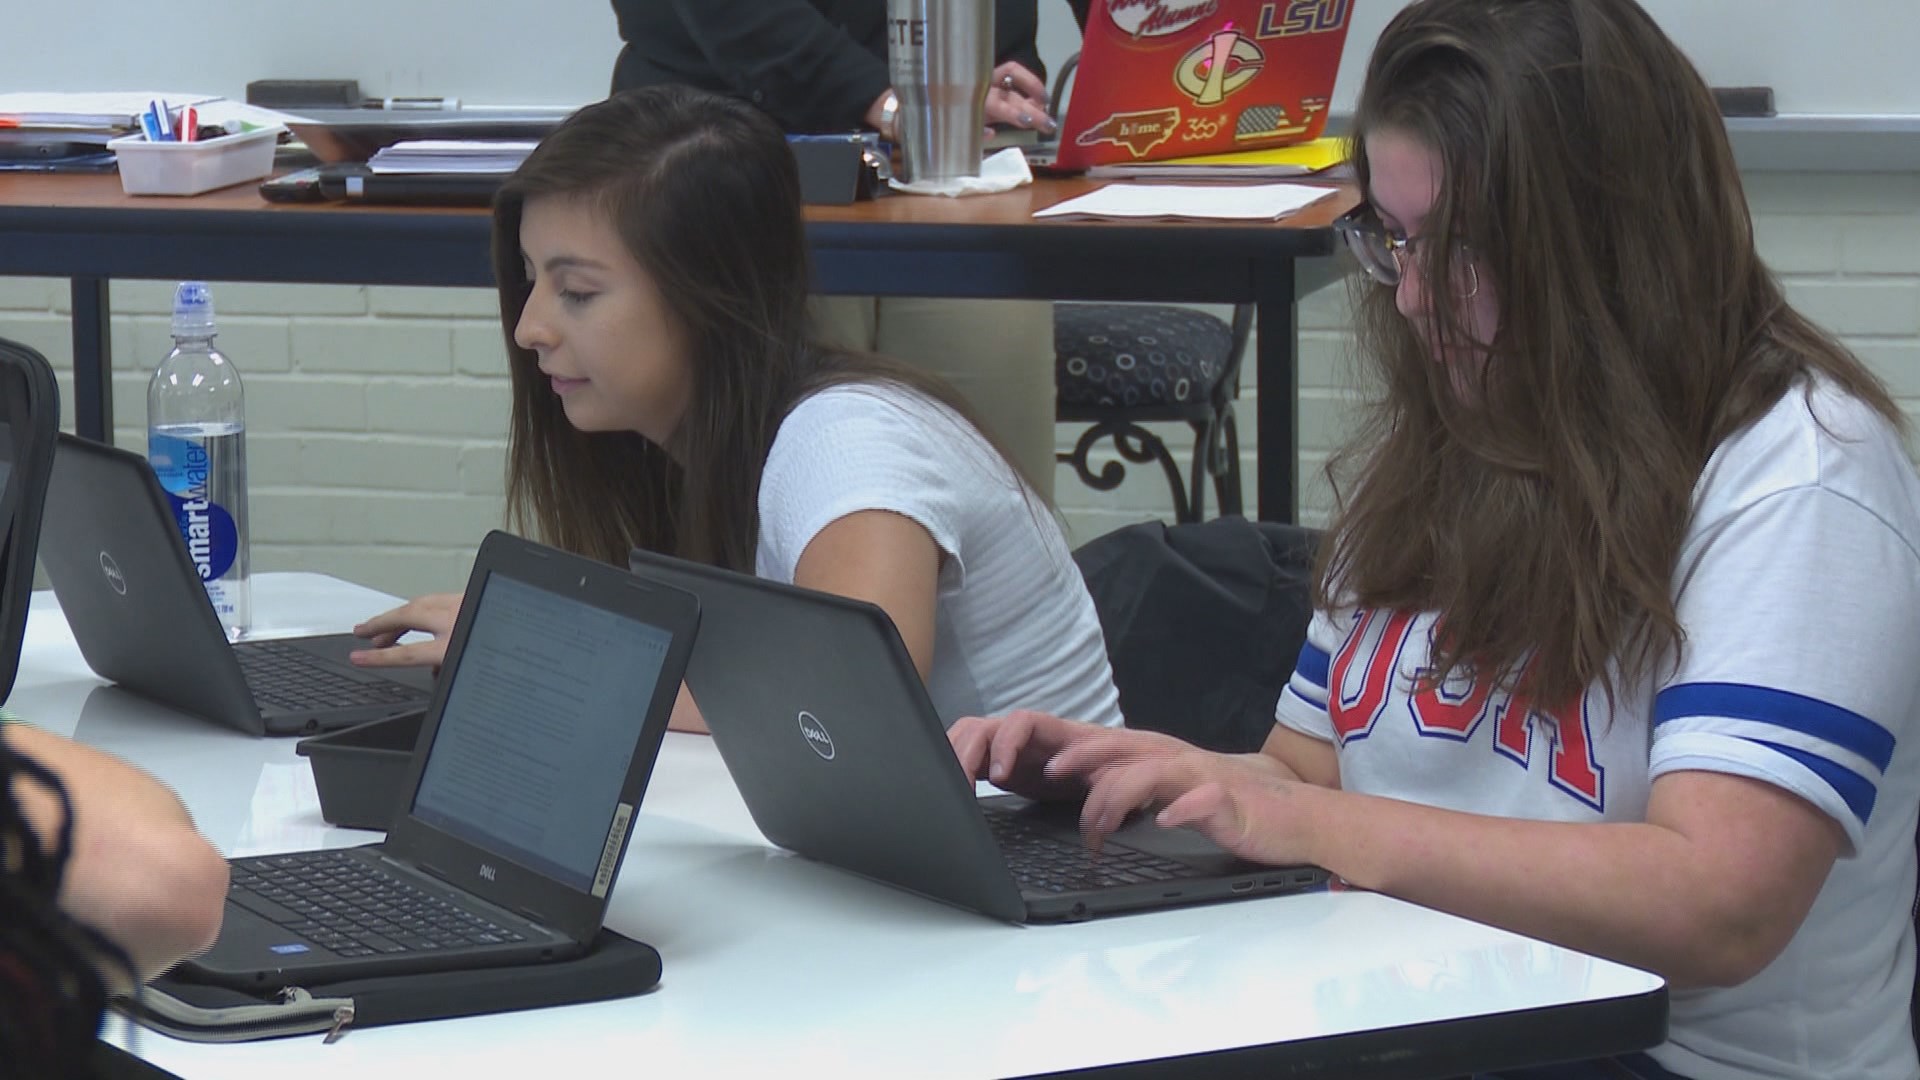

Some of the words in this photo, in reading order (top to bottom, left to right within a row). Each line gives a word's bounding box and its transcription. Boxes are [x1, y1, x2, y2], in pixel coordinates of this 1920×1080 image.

[1255, 0, 1350, 39] LSU
[182, 440, 212, 579] smartwater
[1327, 608, 1604, 813] USA
[803, 726, 830, 745] DELL
[479, 863, 497, 882] DELL
